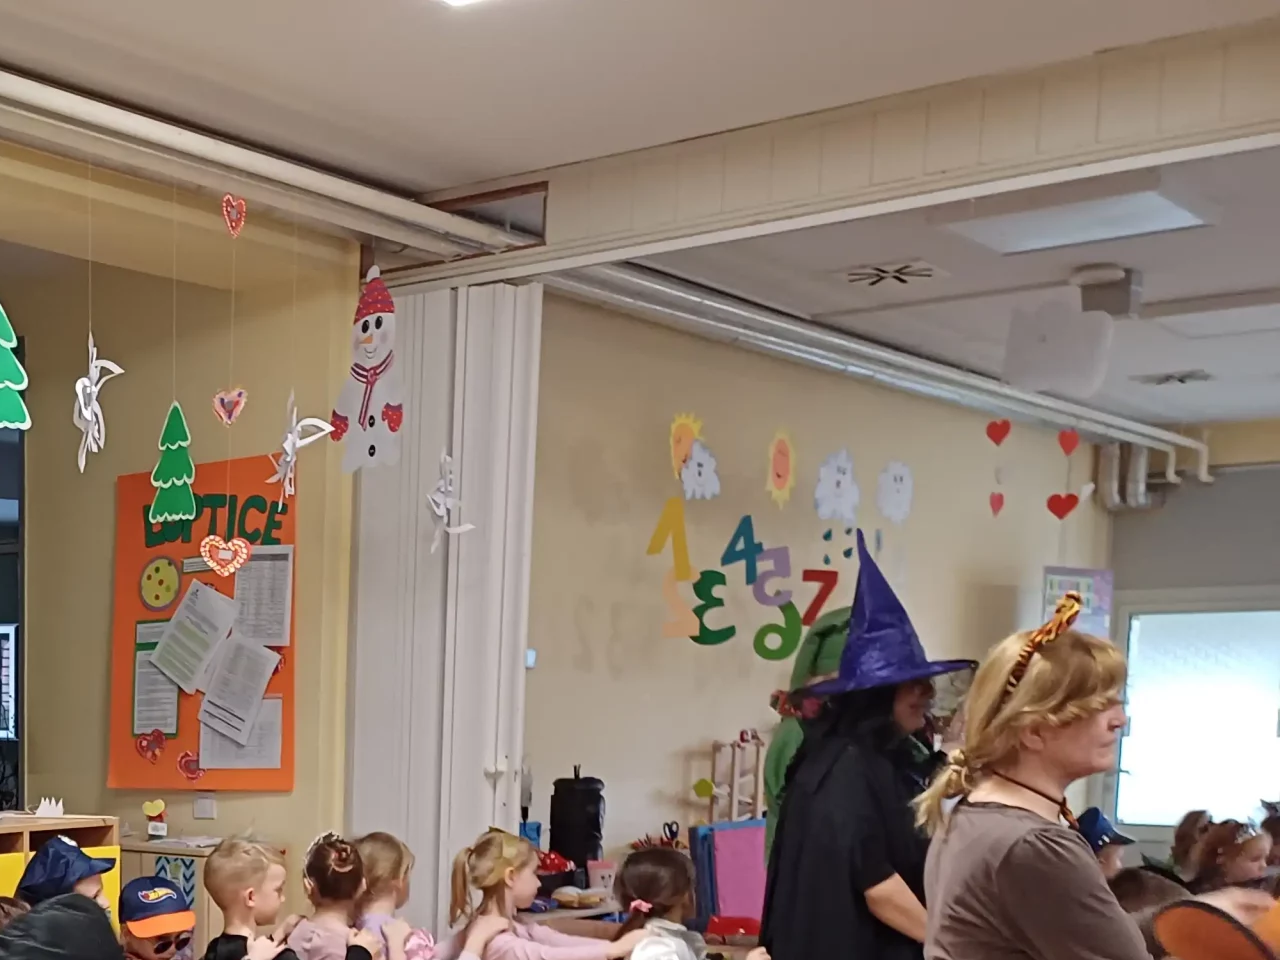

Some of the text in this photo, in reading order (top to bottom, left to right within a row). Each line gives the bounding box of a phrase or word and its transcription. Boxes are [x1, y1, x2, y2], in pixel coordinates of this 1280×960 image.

[646, 496, 692, 581] 1
[720, 515, 764, 585] 4
[801, 569, 839, 626] 7
